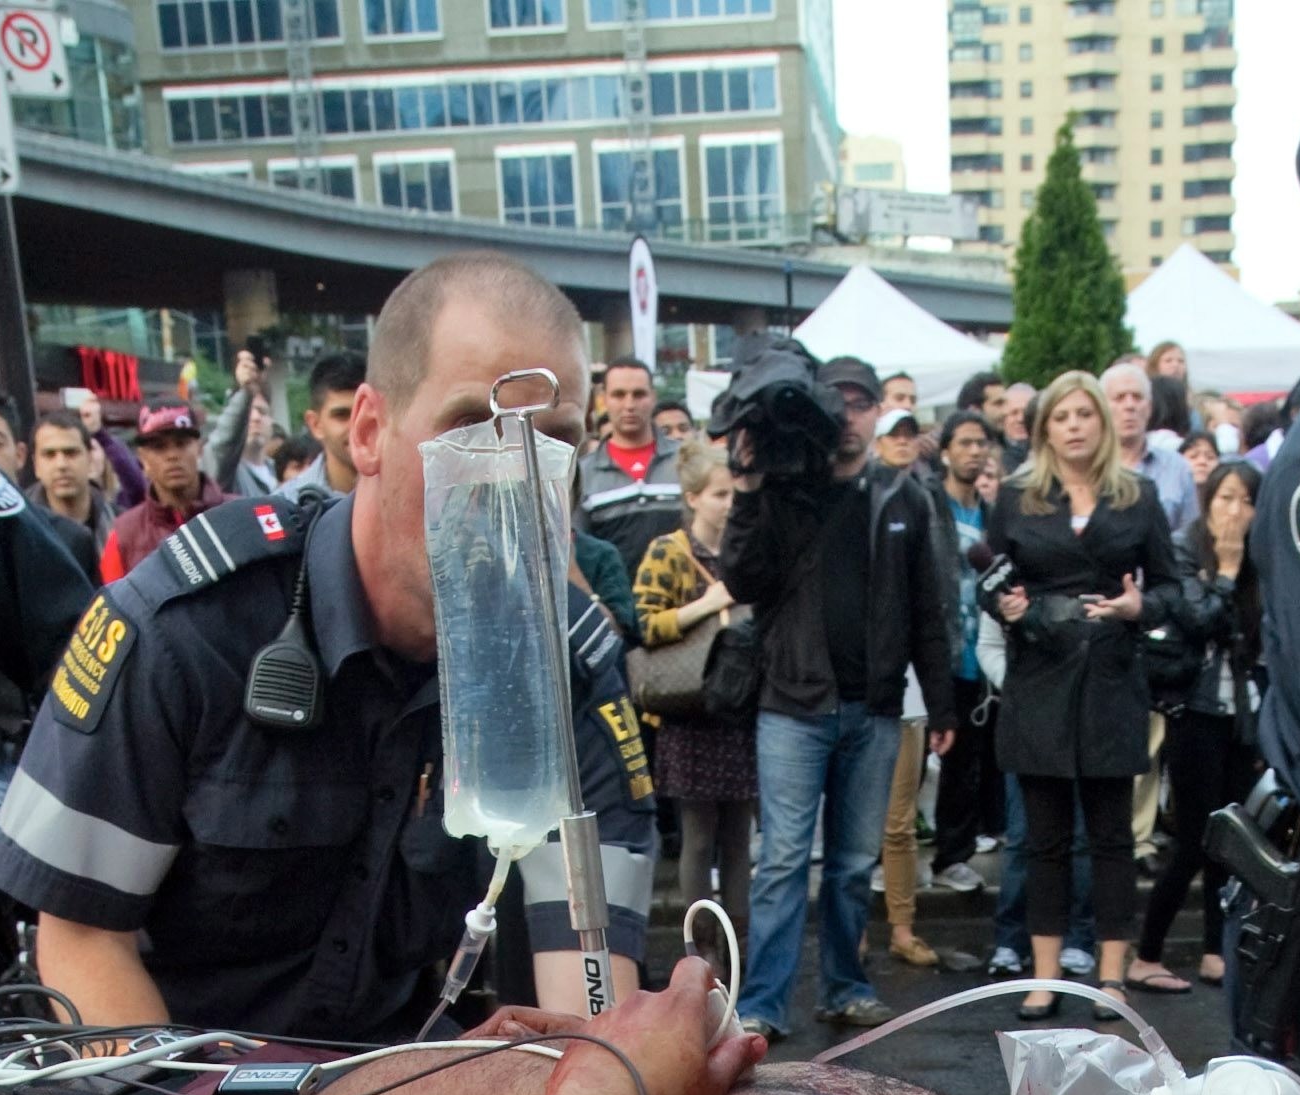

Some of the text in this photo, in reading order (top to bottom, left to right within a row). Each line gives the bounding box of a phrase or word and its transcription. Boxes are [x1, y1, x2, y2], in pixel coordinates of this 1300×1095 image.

[166, 534, 203, 585] PARAMEDIC
[79, 595, 126, 663] EMS
[584, 958, 605, 1015] RNO
[236, 1070, 300, 1080] FERNO
